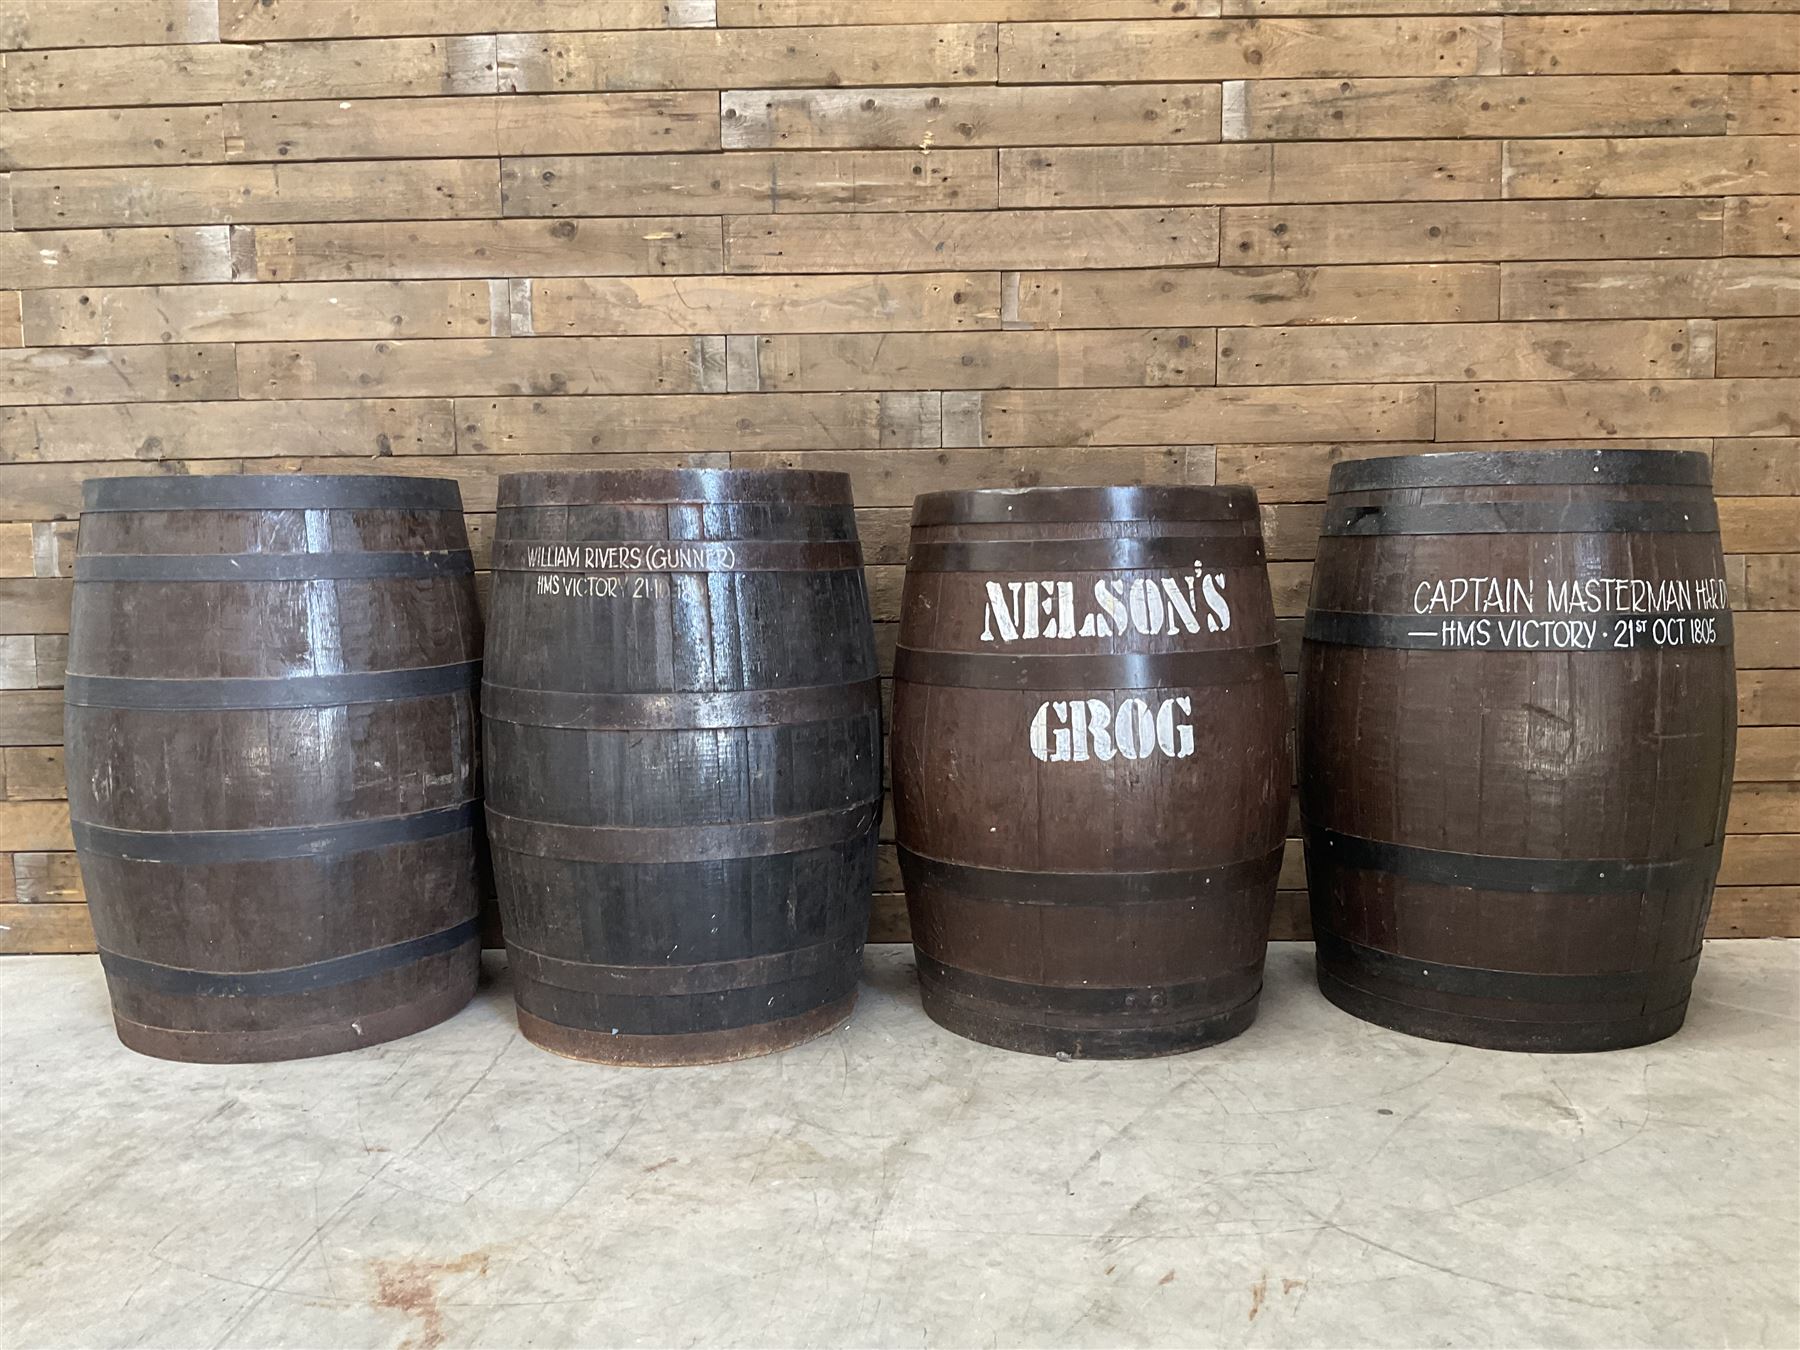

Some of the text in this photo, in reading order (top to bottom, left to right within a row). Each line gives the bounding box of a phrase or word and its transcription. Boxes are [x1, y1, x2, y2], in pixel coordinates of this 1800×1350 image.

[527, 546, 735, 571] WILLIAM RIVERS (GUNNER)
[537, 574, 559, 596] HMS
[563, 576, 628, 599] VICTORY
[980, 559, 1231, 642] NELSON'S
[1413, 576, 1534, 615] CAPTAIN
[1547, 577, 1692, 614] MASTERMAN
[1498, 619, 1597, 649] VICTORY
[1652, 617, 1686, 646] OCT
[1690, 617, 1717, 644] 1805
[1029, 695, 1195, 762] GROG
